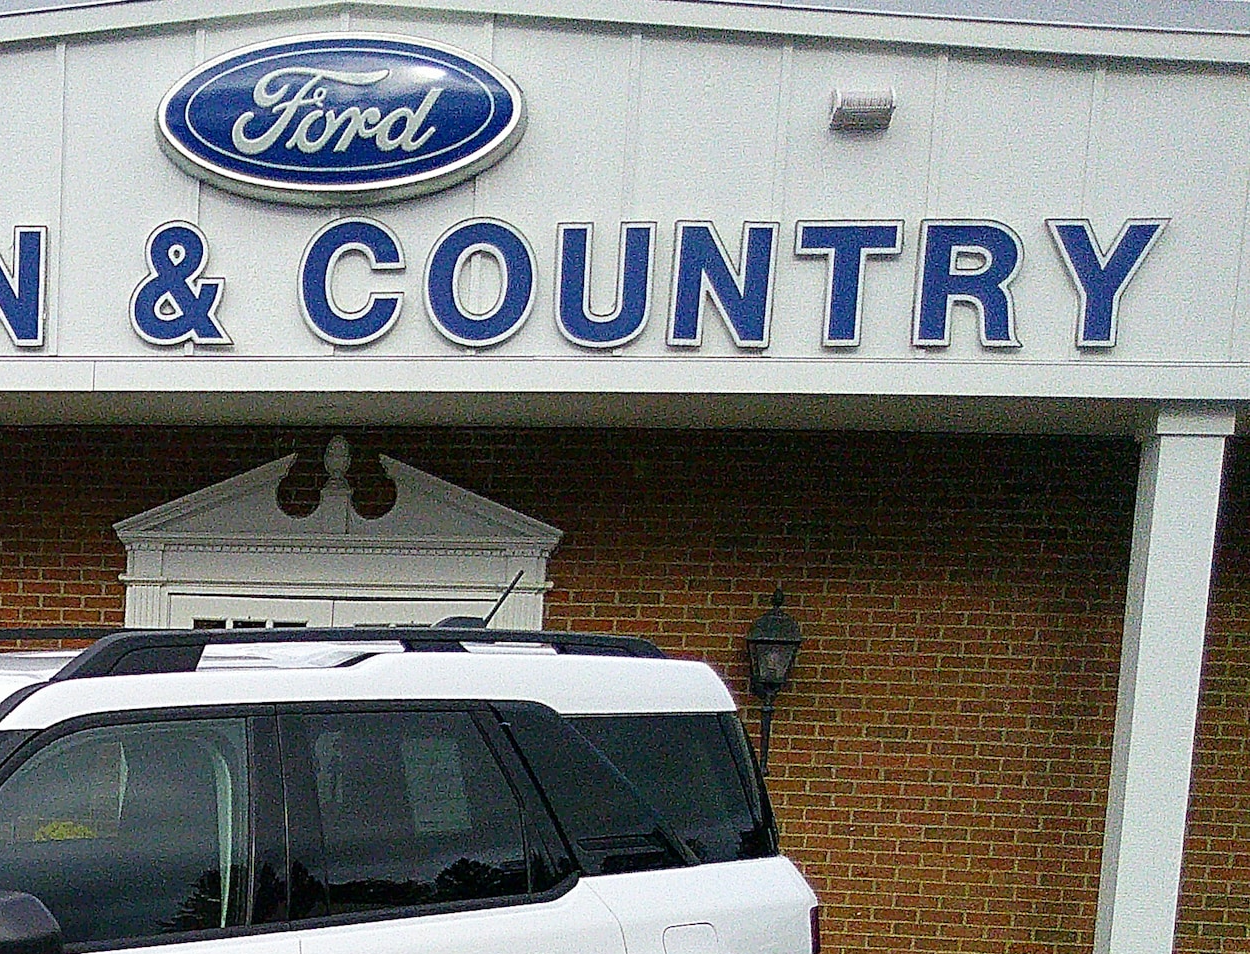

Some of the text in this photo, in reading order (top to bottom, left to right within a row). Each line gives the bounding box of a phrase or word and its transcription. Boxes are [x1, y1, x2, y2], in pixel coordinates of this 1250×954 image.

[231, 66, 444, 155] Ford
[129, 219, 235, 347] &
[298, 216, 1170, 350] COUNTRY
